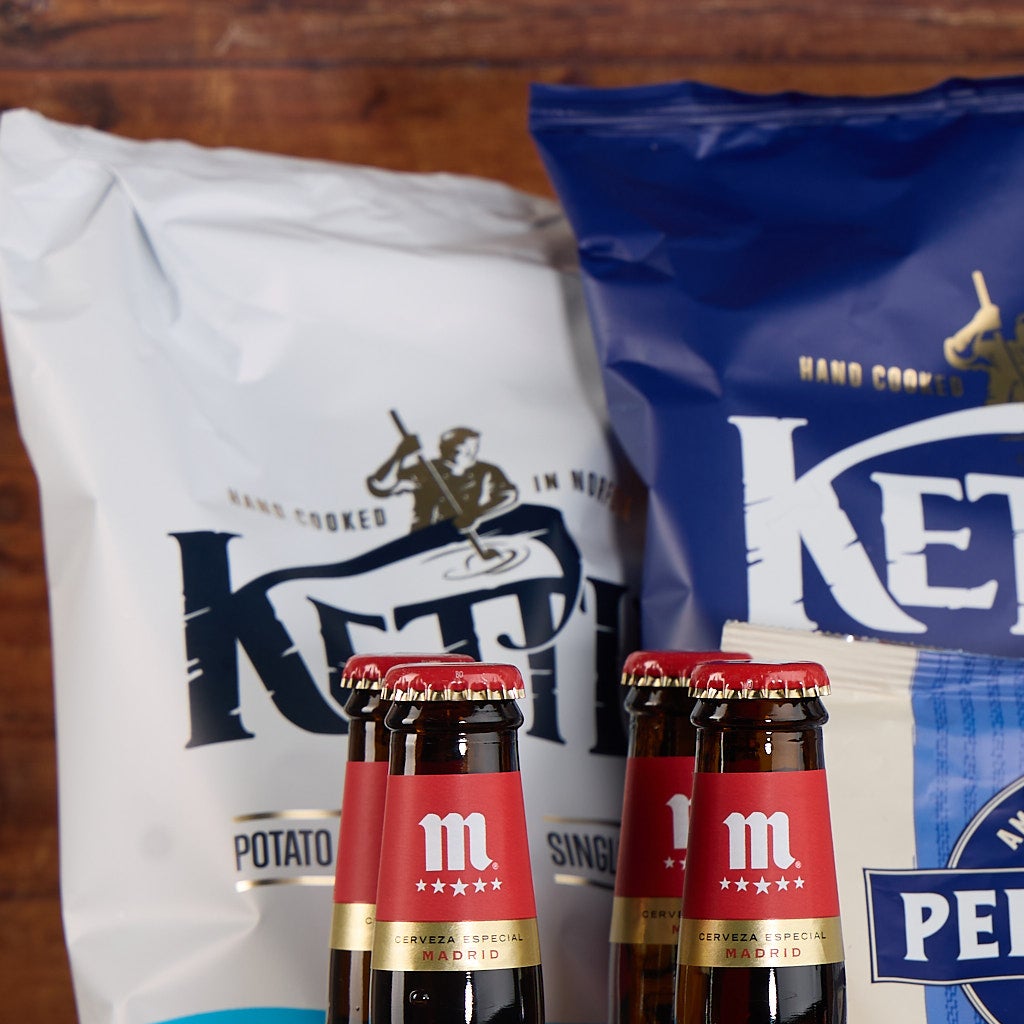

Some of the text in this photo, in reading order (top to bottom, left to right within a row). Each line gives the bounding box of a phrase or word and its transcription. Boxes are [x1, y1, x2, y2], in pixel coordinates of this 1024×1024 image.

[799, 355, 964, 398] HAND COOKED
[534, 474, 558, 493] IN
[227, 488, 387, 533] HAND COOKED
[234, 829, 334, 871] POTATO
[395, 933, 524, 944] CERVEZA ESPECIAL
[699, 931, 827, 942] CERVEZA ESPECIAL
[422, 950, 499, 961] MADRID
[725, 947, 802, 959] MADRID
